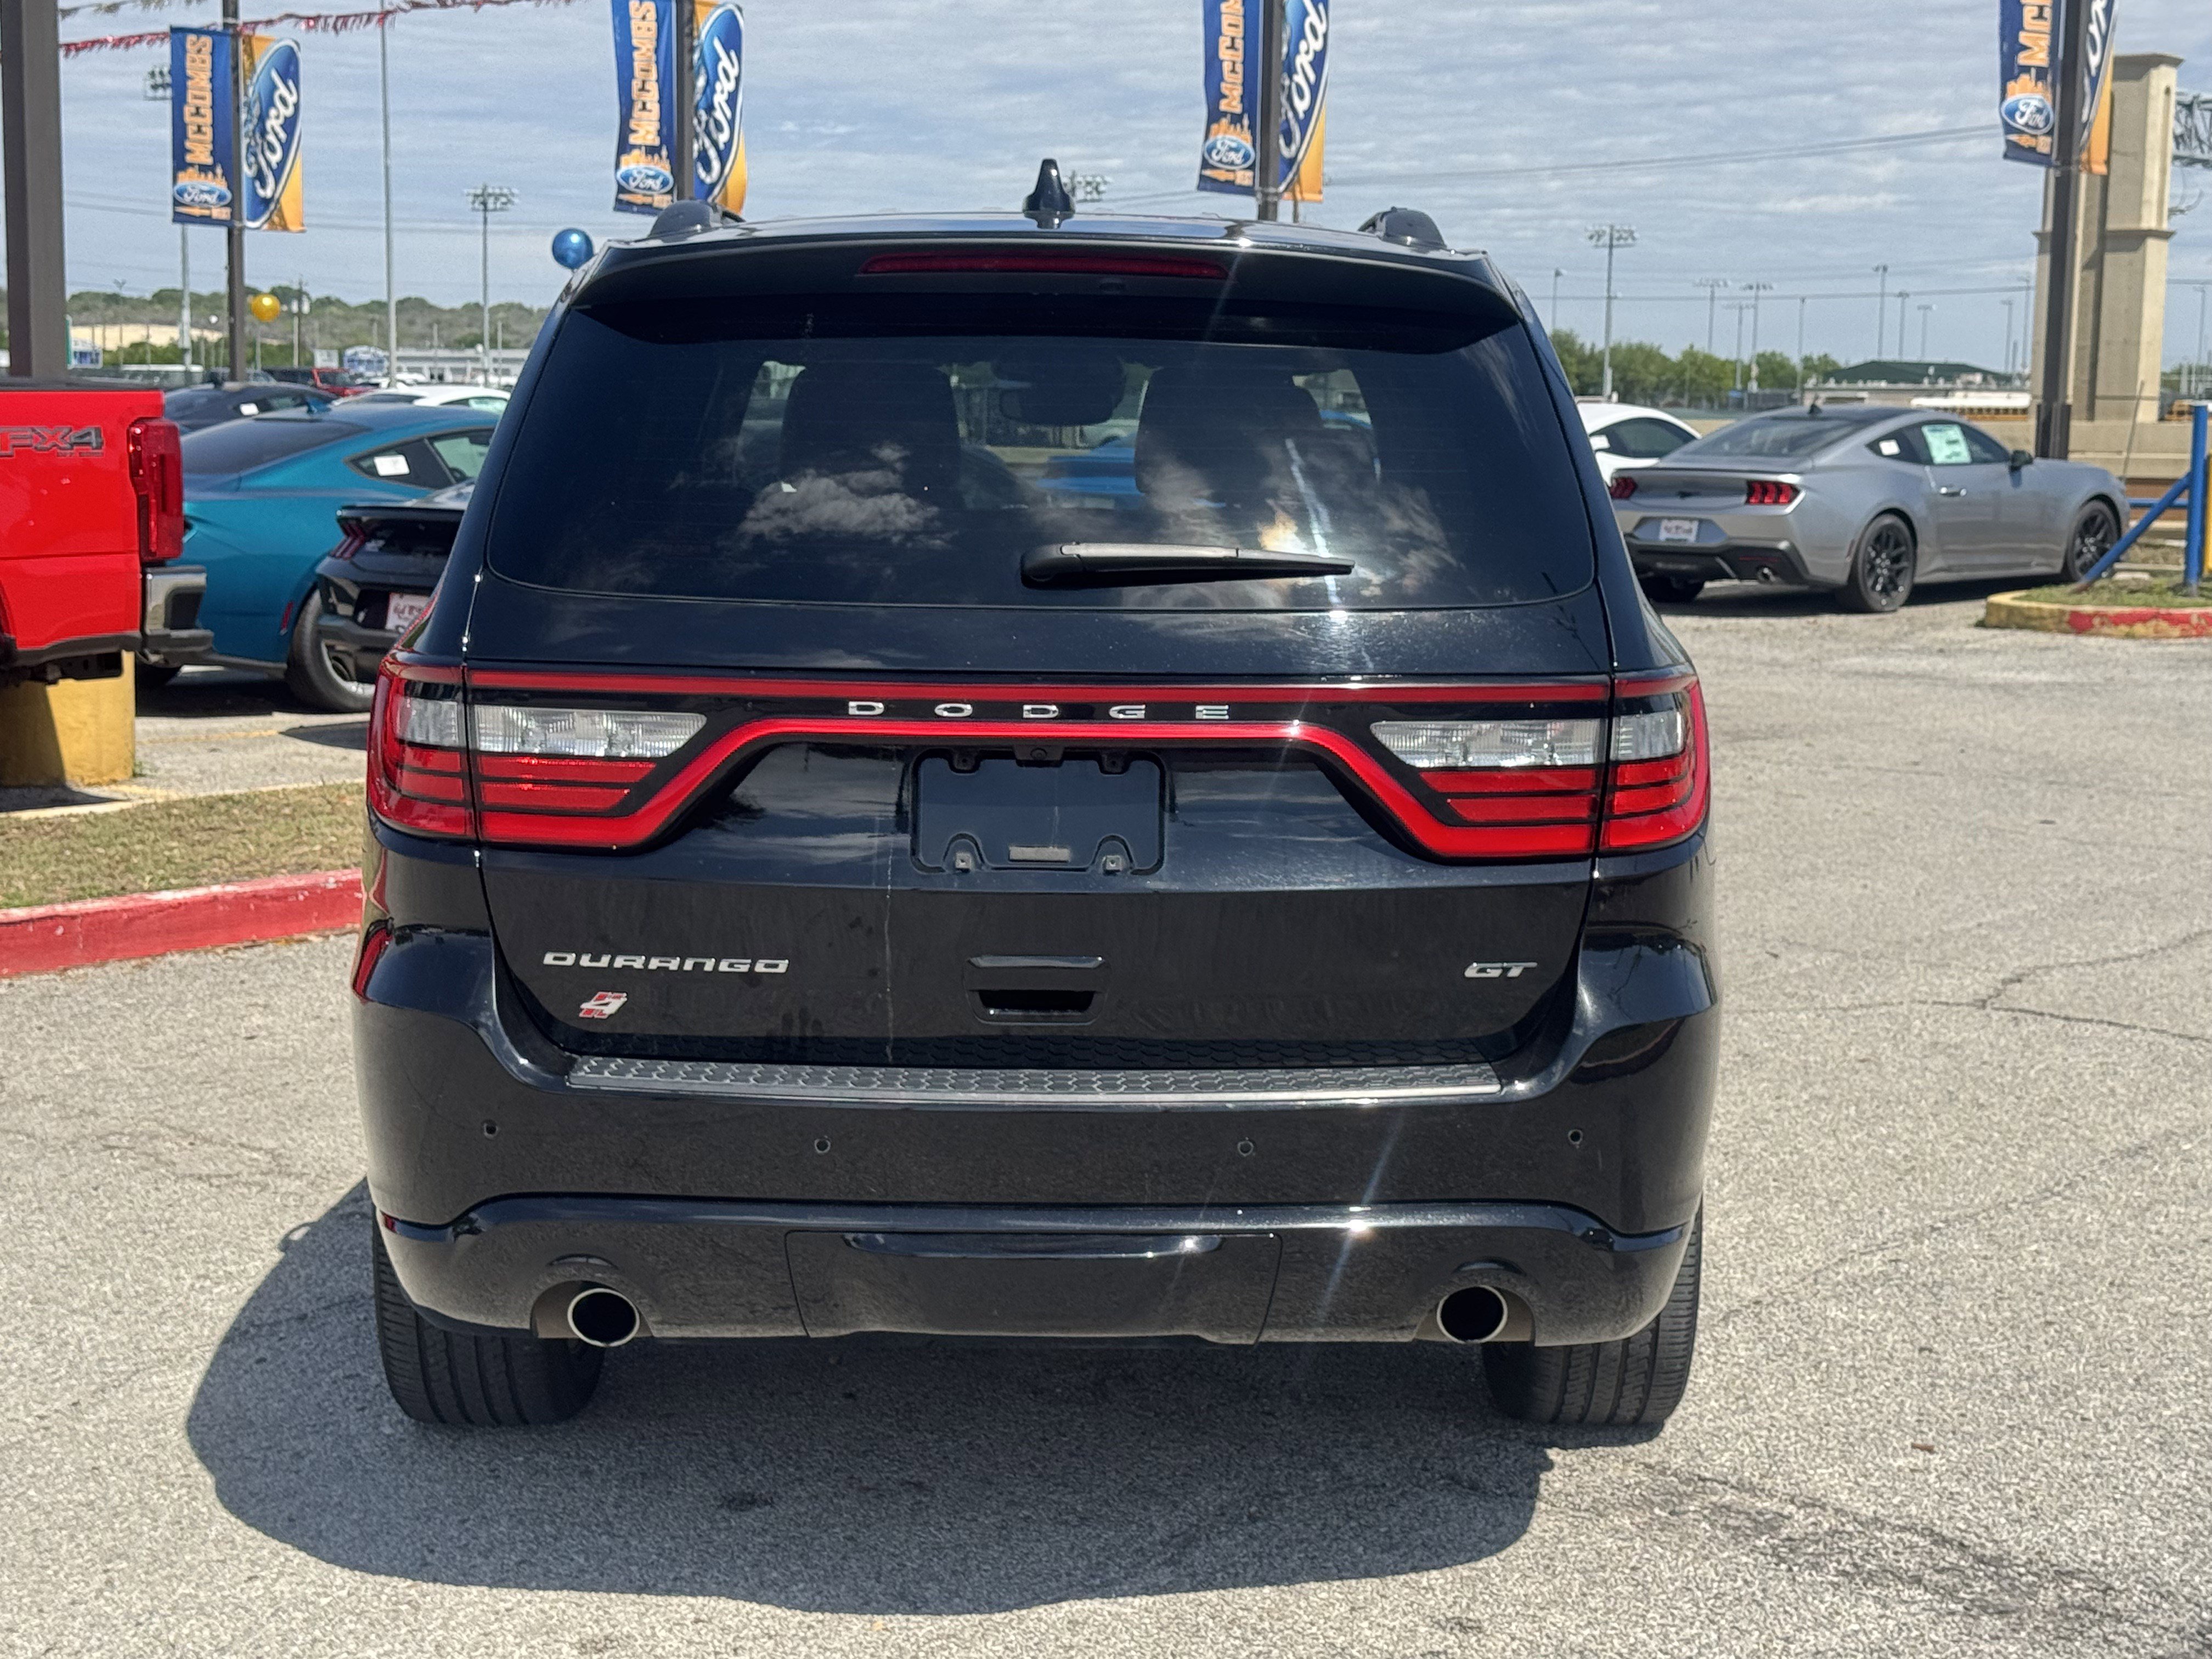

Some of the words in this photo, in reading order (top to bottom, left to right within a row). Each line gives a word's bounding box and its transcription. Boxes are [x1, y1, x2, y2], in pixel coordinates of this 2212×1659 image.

[2015, 99, 2048, 128] Ford
[244, 67, 298, 199] Ford
[1210, 139, 1245, 164] Ford
[629, 168, 665, 190] Ford
[183, 185, 220, 204] Ford
[0, 426, 104, 459] FX4
[848, 700, 1231, 720] DODGE
[543, 951, 789, 974] DURANGO
[1464, 962, 1538, 978] GT
